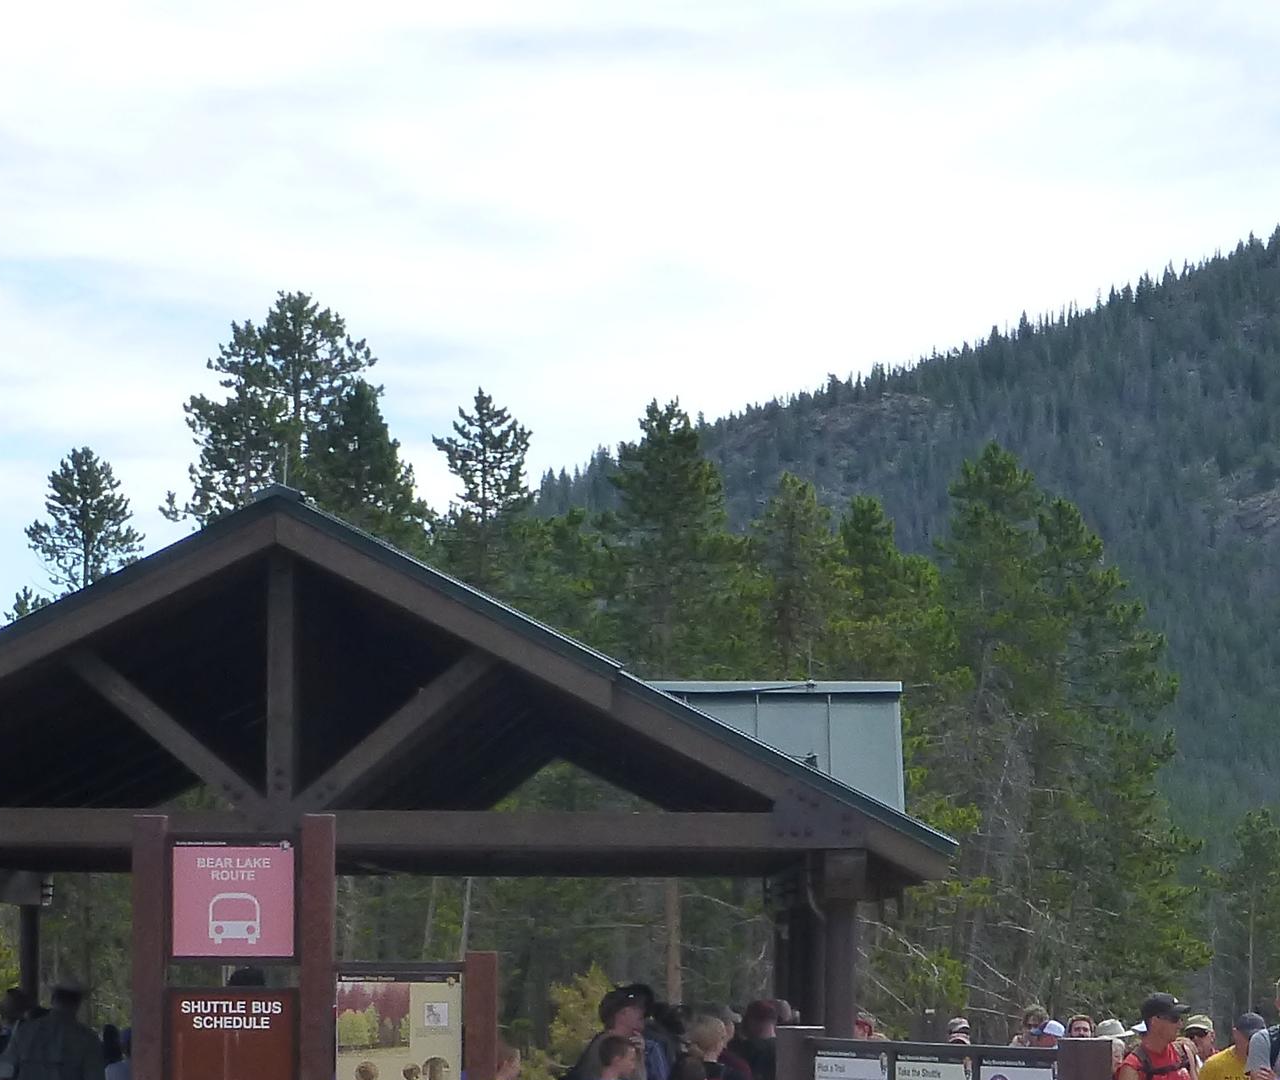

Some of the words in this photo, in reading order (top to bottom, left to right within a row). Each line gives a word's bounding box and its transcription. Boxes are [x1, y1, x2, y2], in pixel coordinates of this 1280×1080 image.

[196, 857, 234, 869] BEAR
[236, 857, 272, 869] LAKE
[210, 870, 256, 881] ROUTE
[180, 1001, 247, 1014] SHUTTLE
[251, 1001, 283, 1014] BUS
[192, 1016, 271, 1029] SCHEDULE
